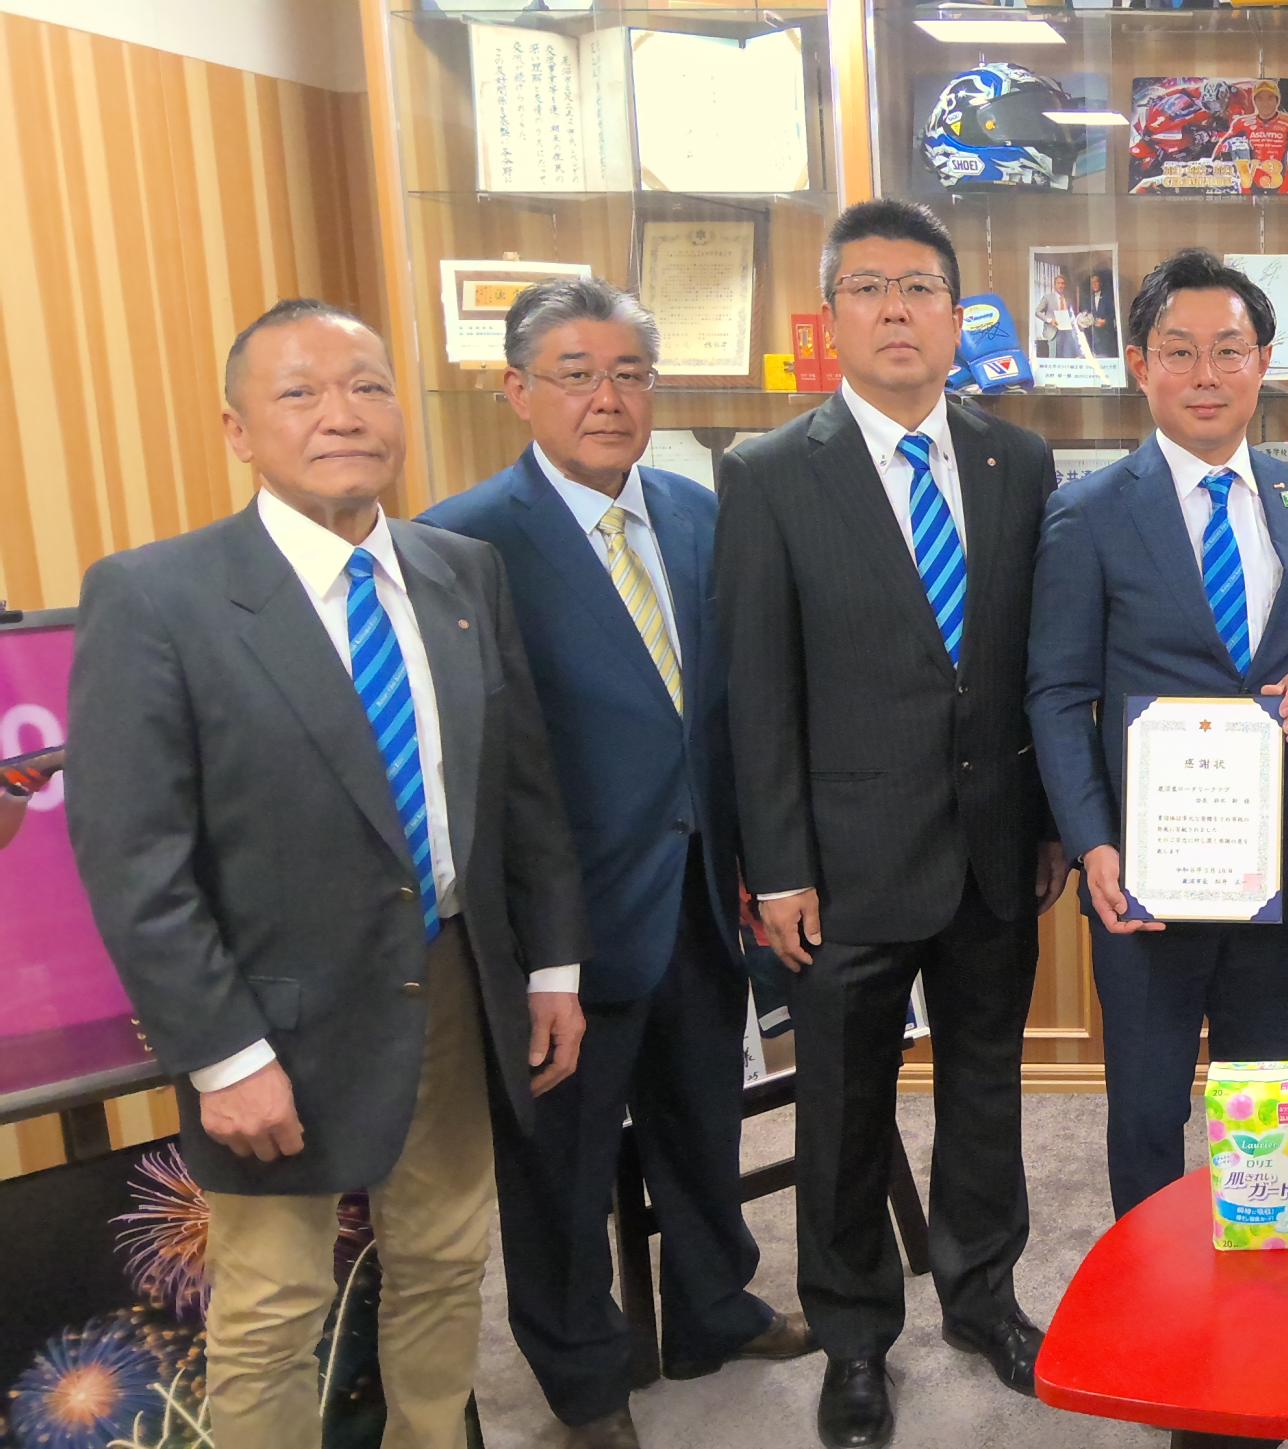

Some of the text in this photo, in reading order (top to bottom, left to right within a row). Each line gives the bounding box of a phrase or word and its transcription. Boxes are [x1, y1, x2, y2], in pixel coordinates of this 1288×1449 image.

[952, 160, 978, 171] SHOEI
[1184, 758, 1226, 770] 感謝状
[1242, 1140, 1280, 1150] Laurier
[1246, 1159, 1273, 1168] ロリエ
[1226, 1172, 1277, 1186] 肌きれい
[1223, 1240, 1233, 1248] 20
